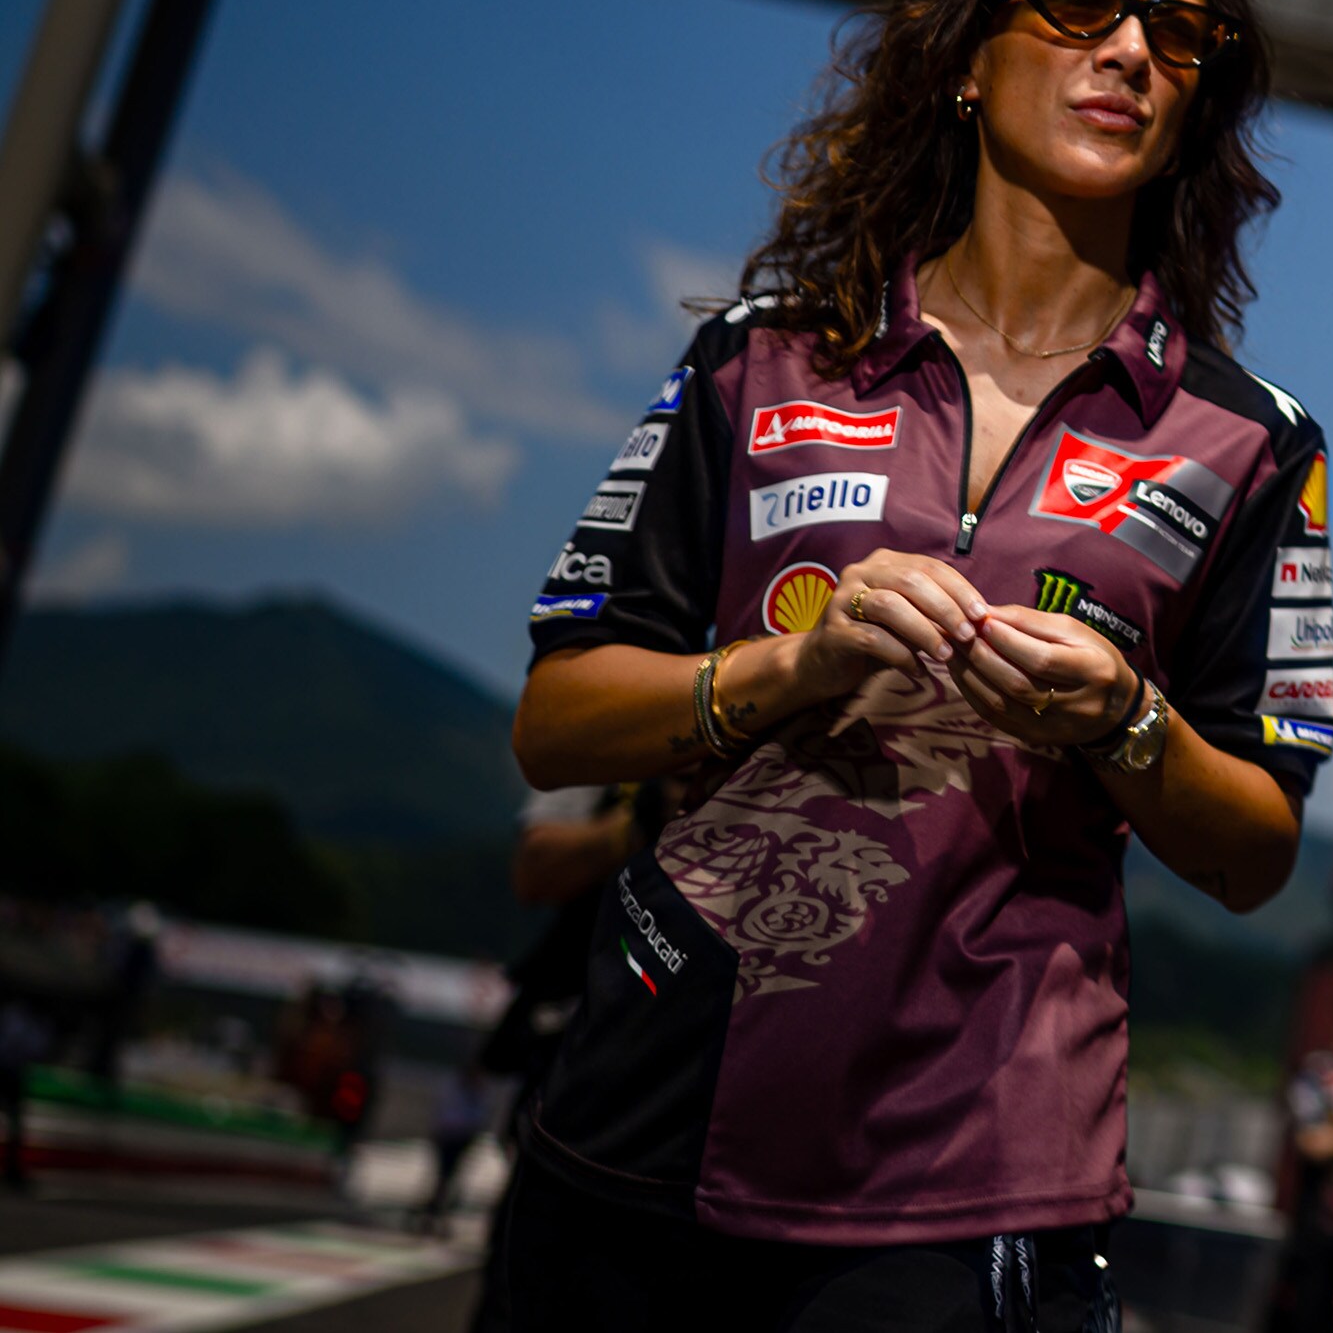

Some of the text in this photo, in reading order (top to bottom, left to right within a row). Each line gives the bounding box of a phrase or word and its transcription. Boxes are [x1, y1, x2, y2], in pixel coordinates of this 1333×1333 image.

[789, 415, 894, 439] AUTOGRILL
[784, 479, 872, 519] riello
[1136, 481, 1209, 540] Lenovo
[1078, 598, 1142, 645] MONSTER
